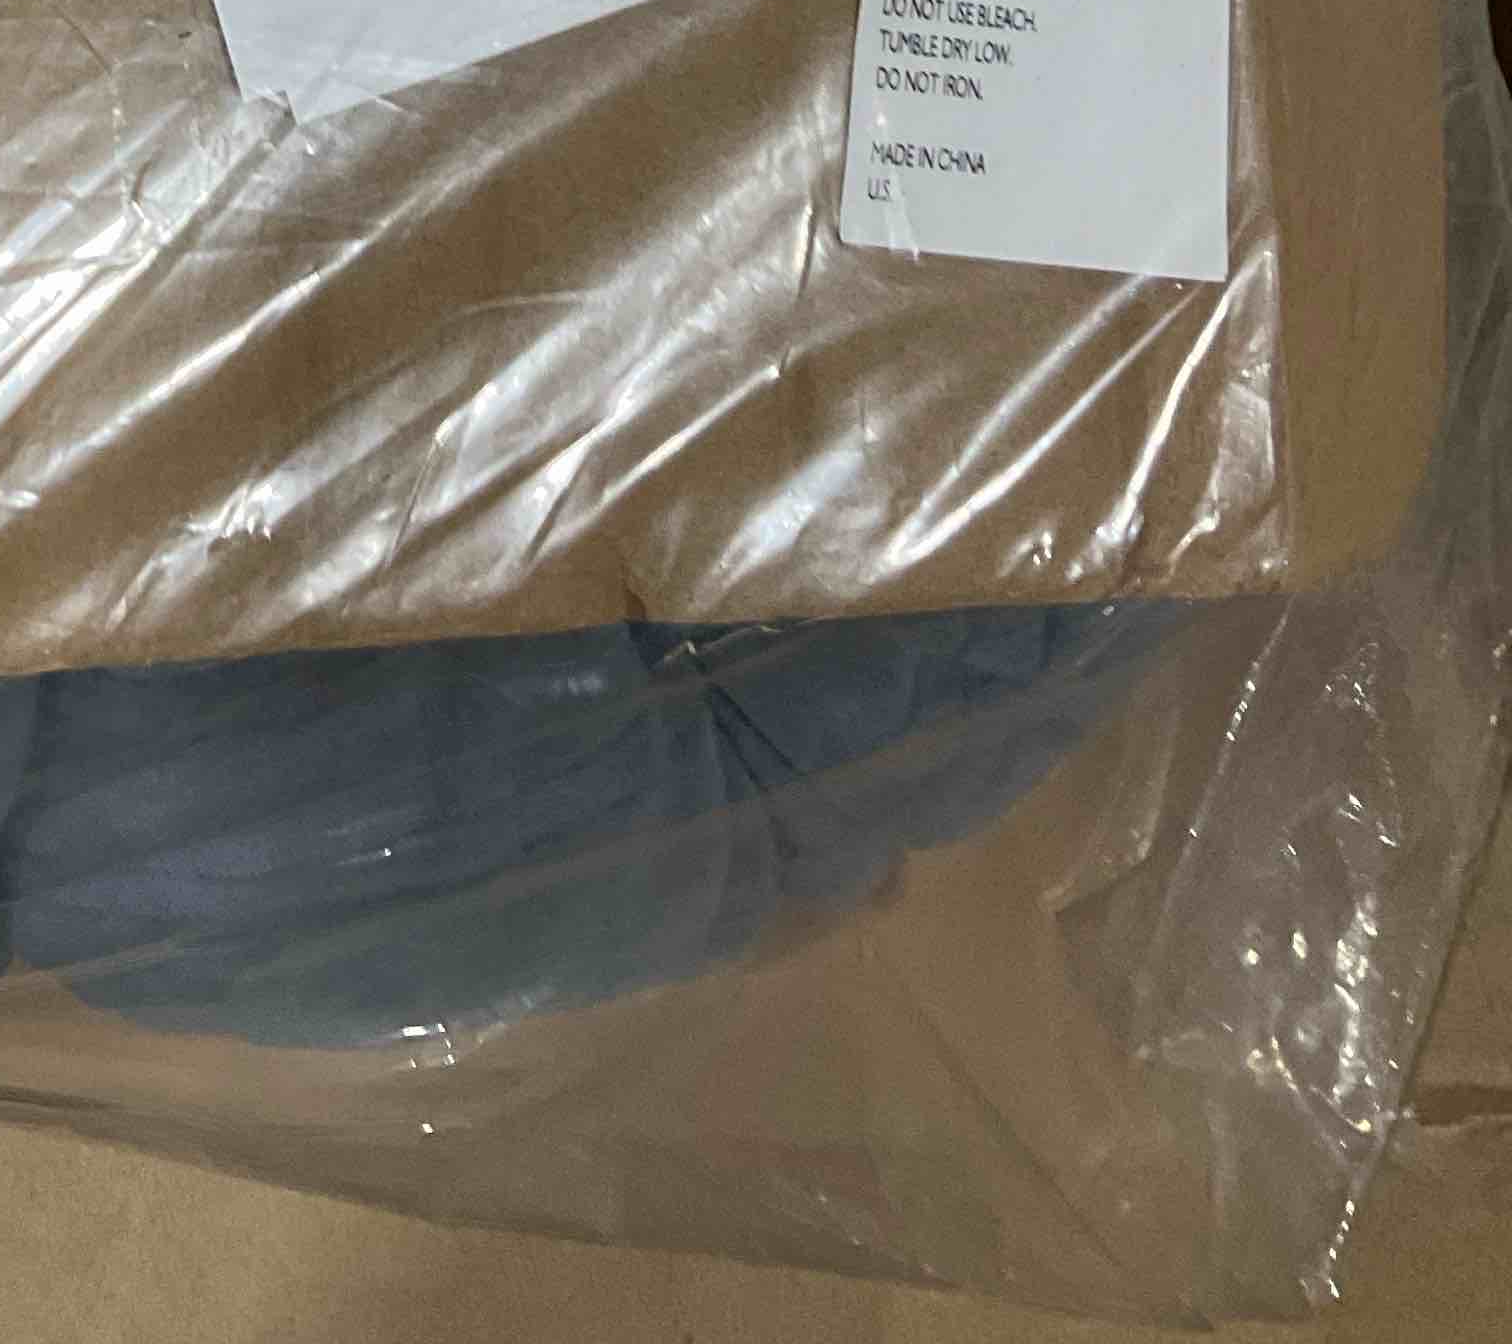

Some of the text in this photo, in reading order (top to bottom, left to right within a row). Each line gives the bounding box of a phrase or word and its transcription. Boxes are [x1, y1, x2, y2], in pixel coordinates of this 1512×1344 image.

[948, 0, 975, 26] USE
[879, 27, 939, 58] TUMBLE
[941, 35, 973, 62] DRY
[875, 65, 902, 91] DO
[904, 68, 941, 94] NOT
[870, 140, 987, 175] MADE IN CHINA
